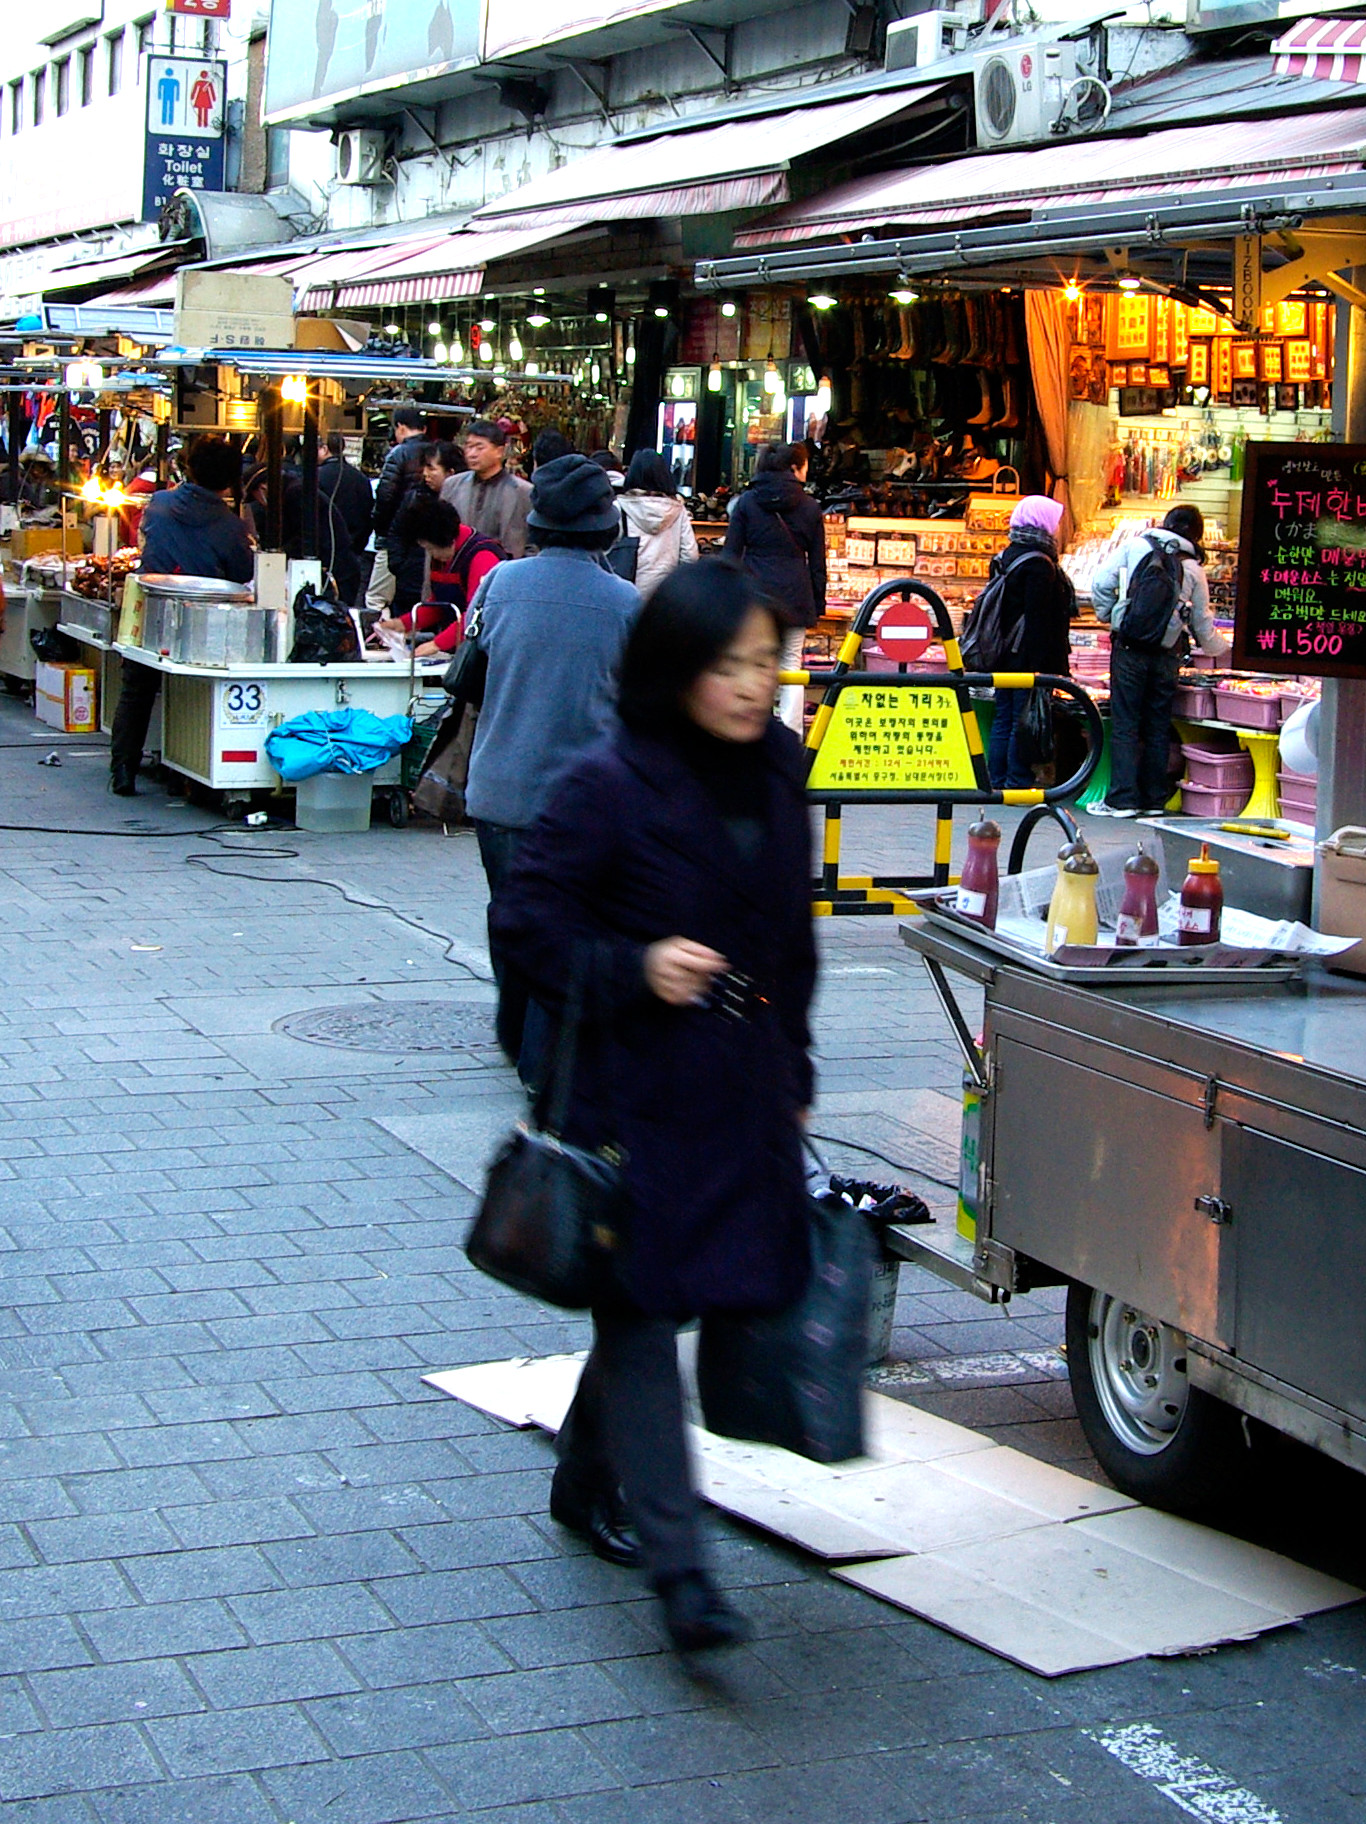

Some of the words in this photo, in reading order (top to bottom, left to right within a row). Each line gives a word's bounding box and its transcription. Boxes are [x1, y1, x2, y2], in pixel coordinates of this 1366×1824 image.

[1022, 81, 1032, 92] LG
[157, 143, 210, 159] 화장실
[164, 160, 203, 174] Toilet
[228, 684, 261, 711] 33
[861, 693, 899, 709] 차없는
[908, 693, 933, 709] 거리
[845, 717, 873, 728] 이곳은
[879, 717, 916, 728] 보행자의
[853, 744, 890, 755] 제한하고
